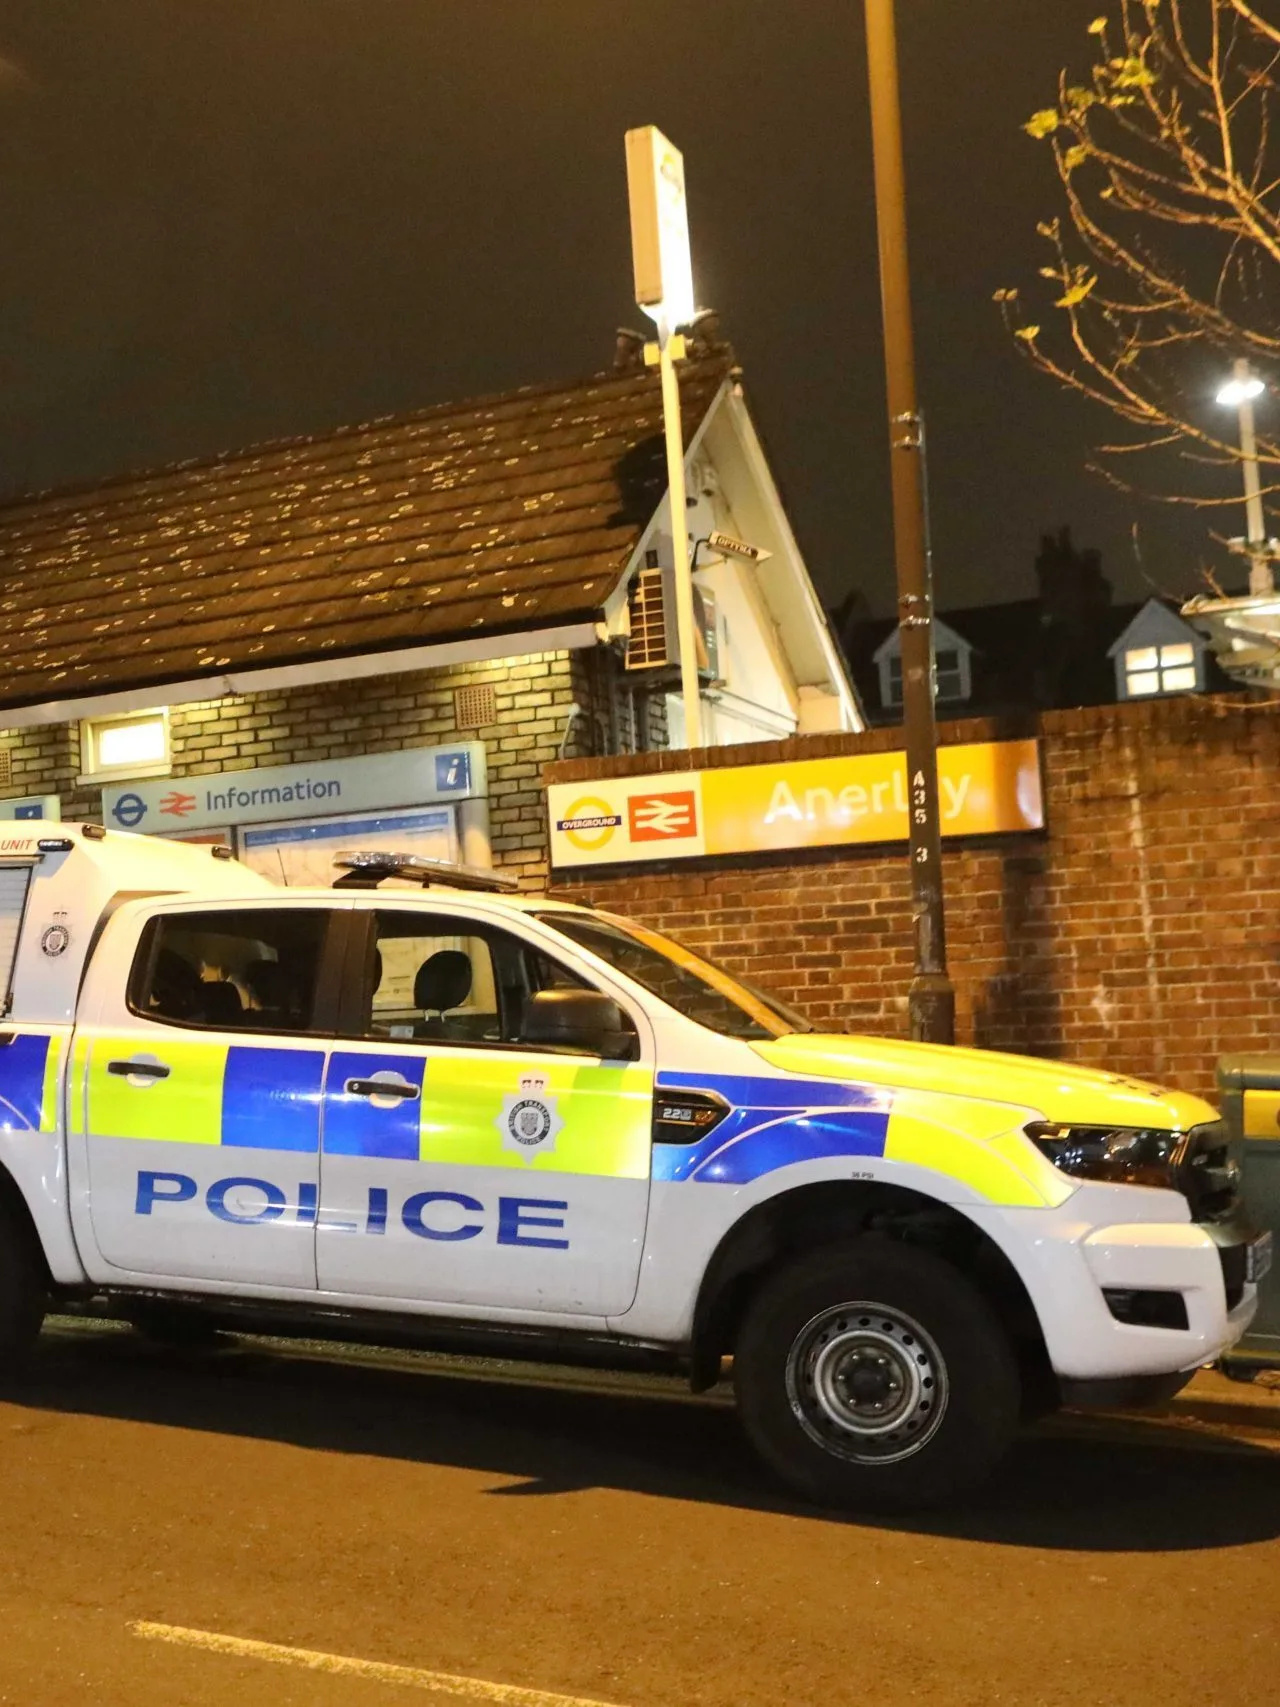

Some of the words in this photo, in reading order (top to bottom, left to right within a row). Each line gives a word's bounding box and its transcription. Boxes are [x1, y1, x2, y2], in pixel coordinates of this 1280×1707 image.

[207, 778, 341, 811] Information
[763, 770, 972, 824] Anerly
[562, 816, 616, 830] OVERGROUND
[1, 839, 34, 850] UNIT
[135, 1170, 569, 1250] POLICE
